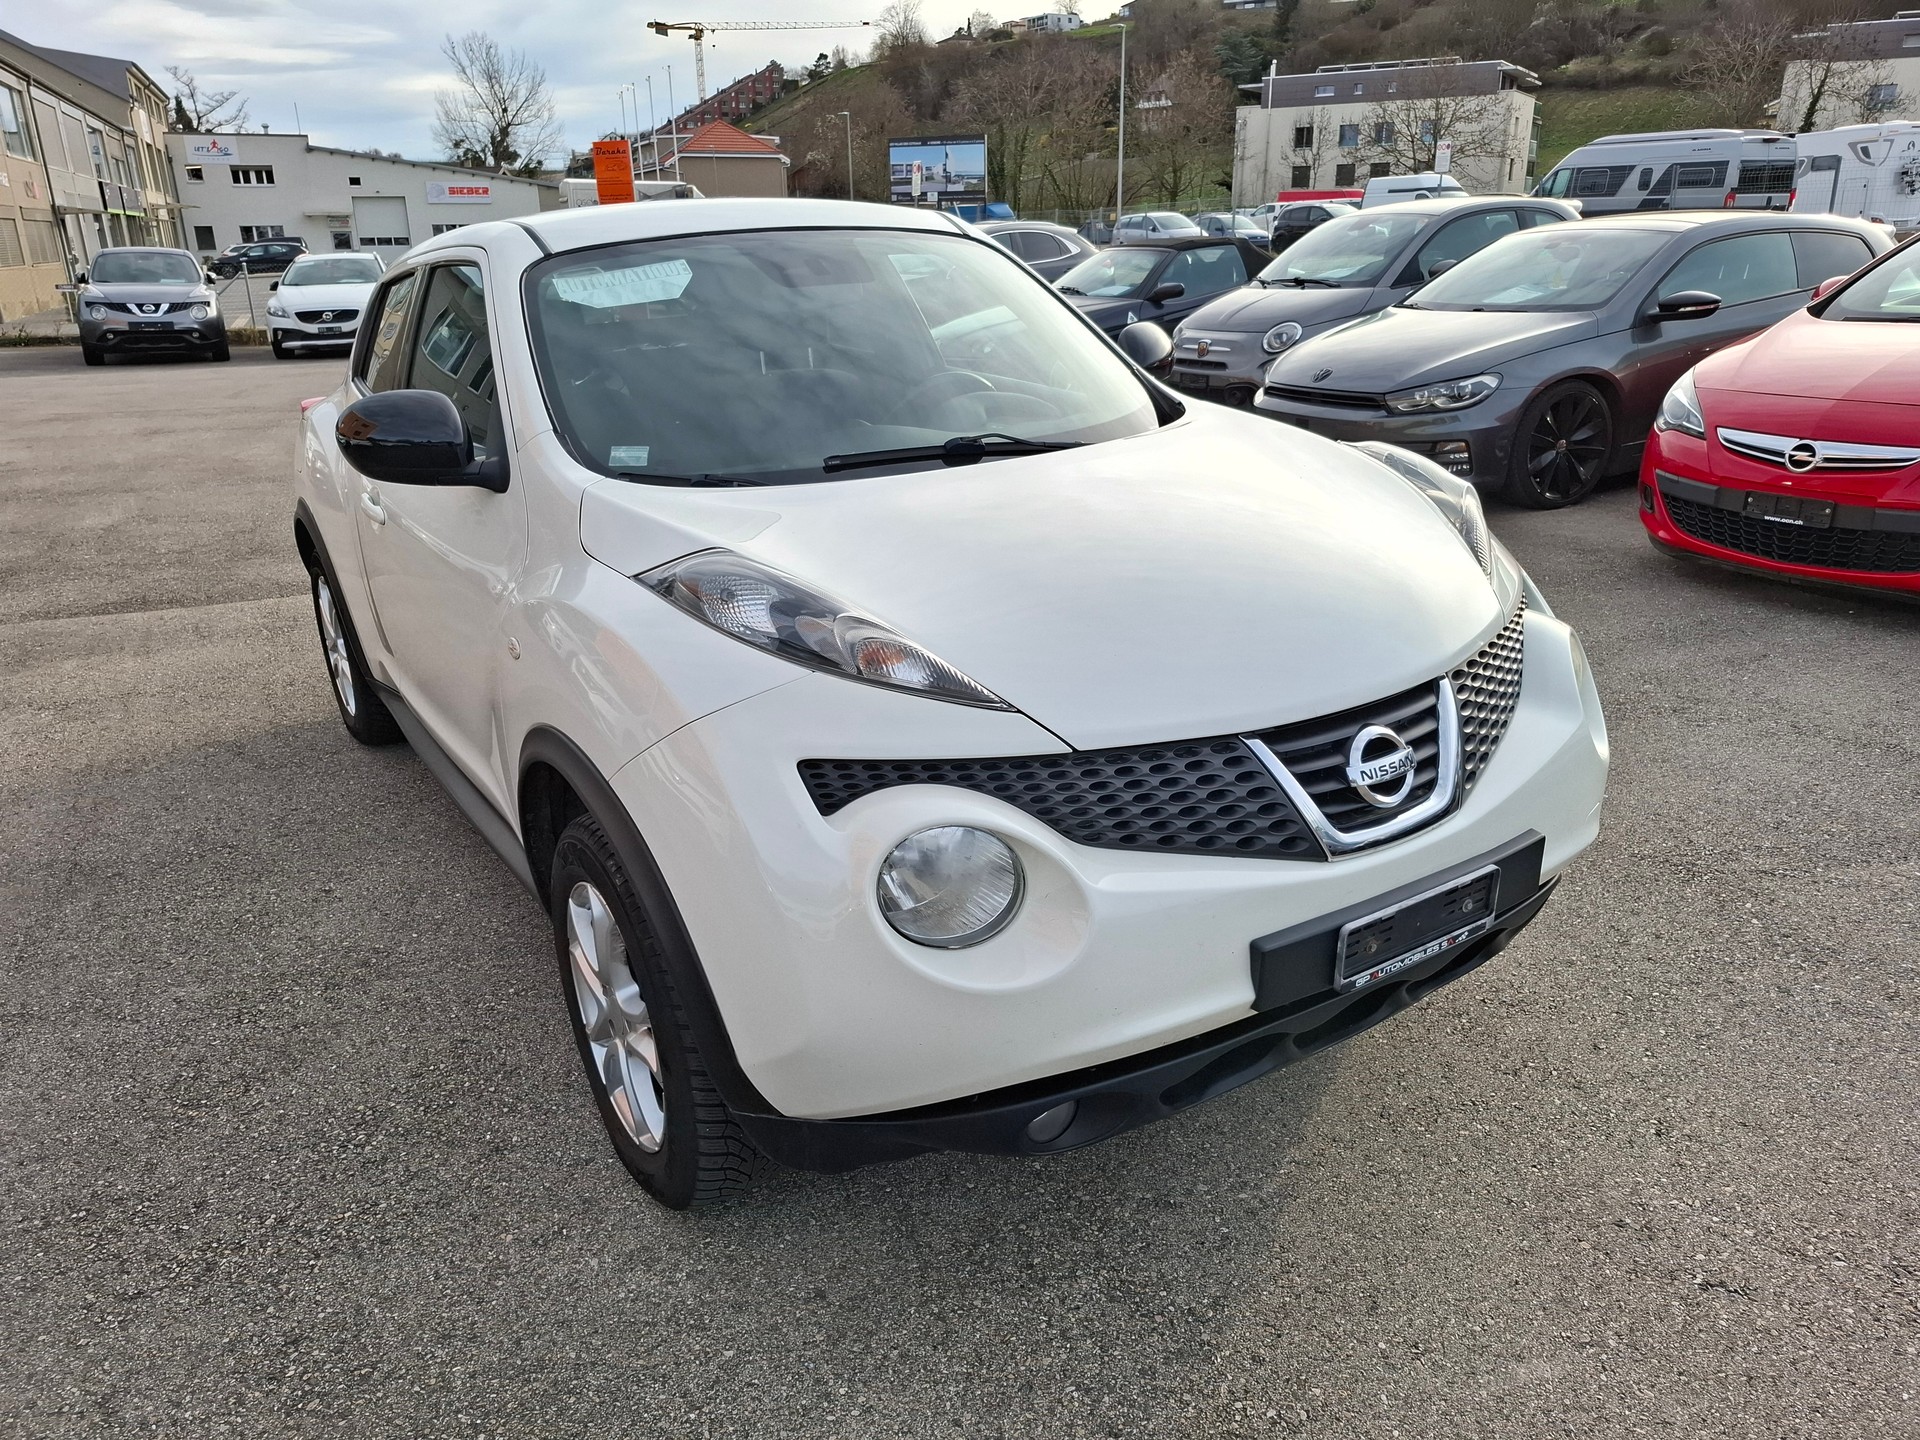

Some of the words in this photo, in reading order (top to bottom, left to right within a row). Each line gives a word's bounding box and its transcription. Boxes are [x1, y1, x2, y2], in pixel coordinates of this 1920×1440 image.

[448, 186, 490, 196] SIEBER
[555, 260, 690, 294] AUTOMATIQUE
[1360, 752, 1416, 782] NISSAN
[1355, 975, 1371, 987] GP
[1371, 944, 1440, 980] AUTOMOBILES
[1440, 937, 1456, 950] SA
